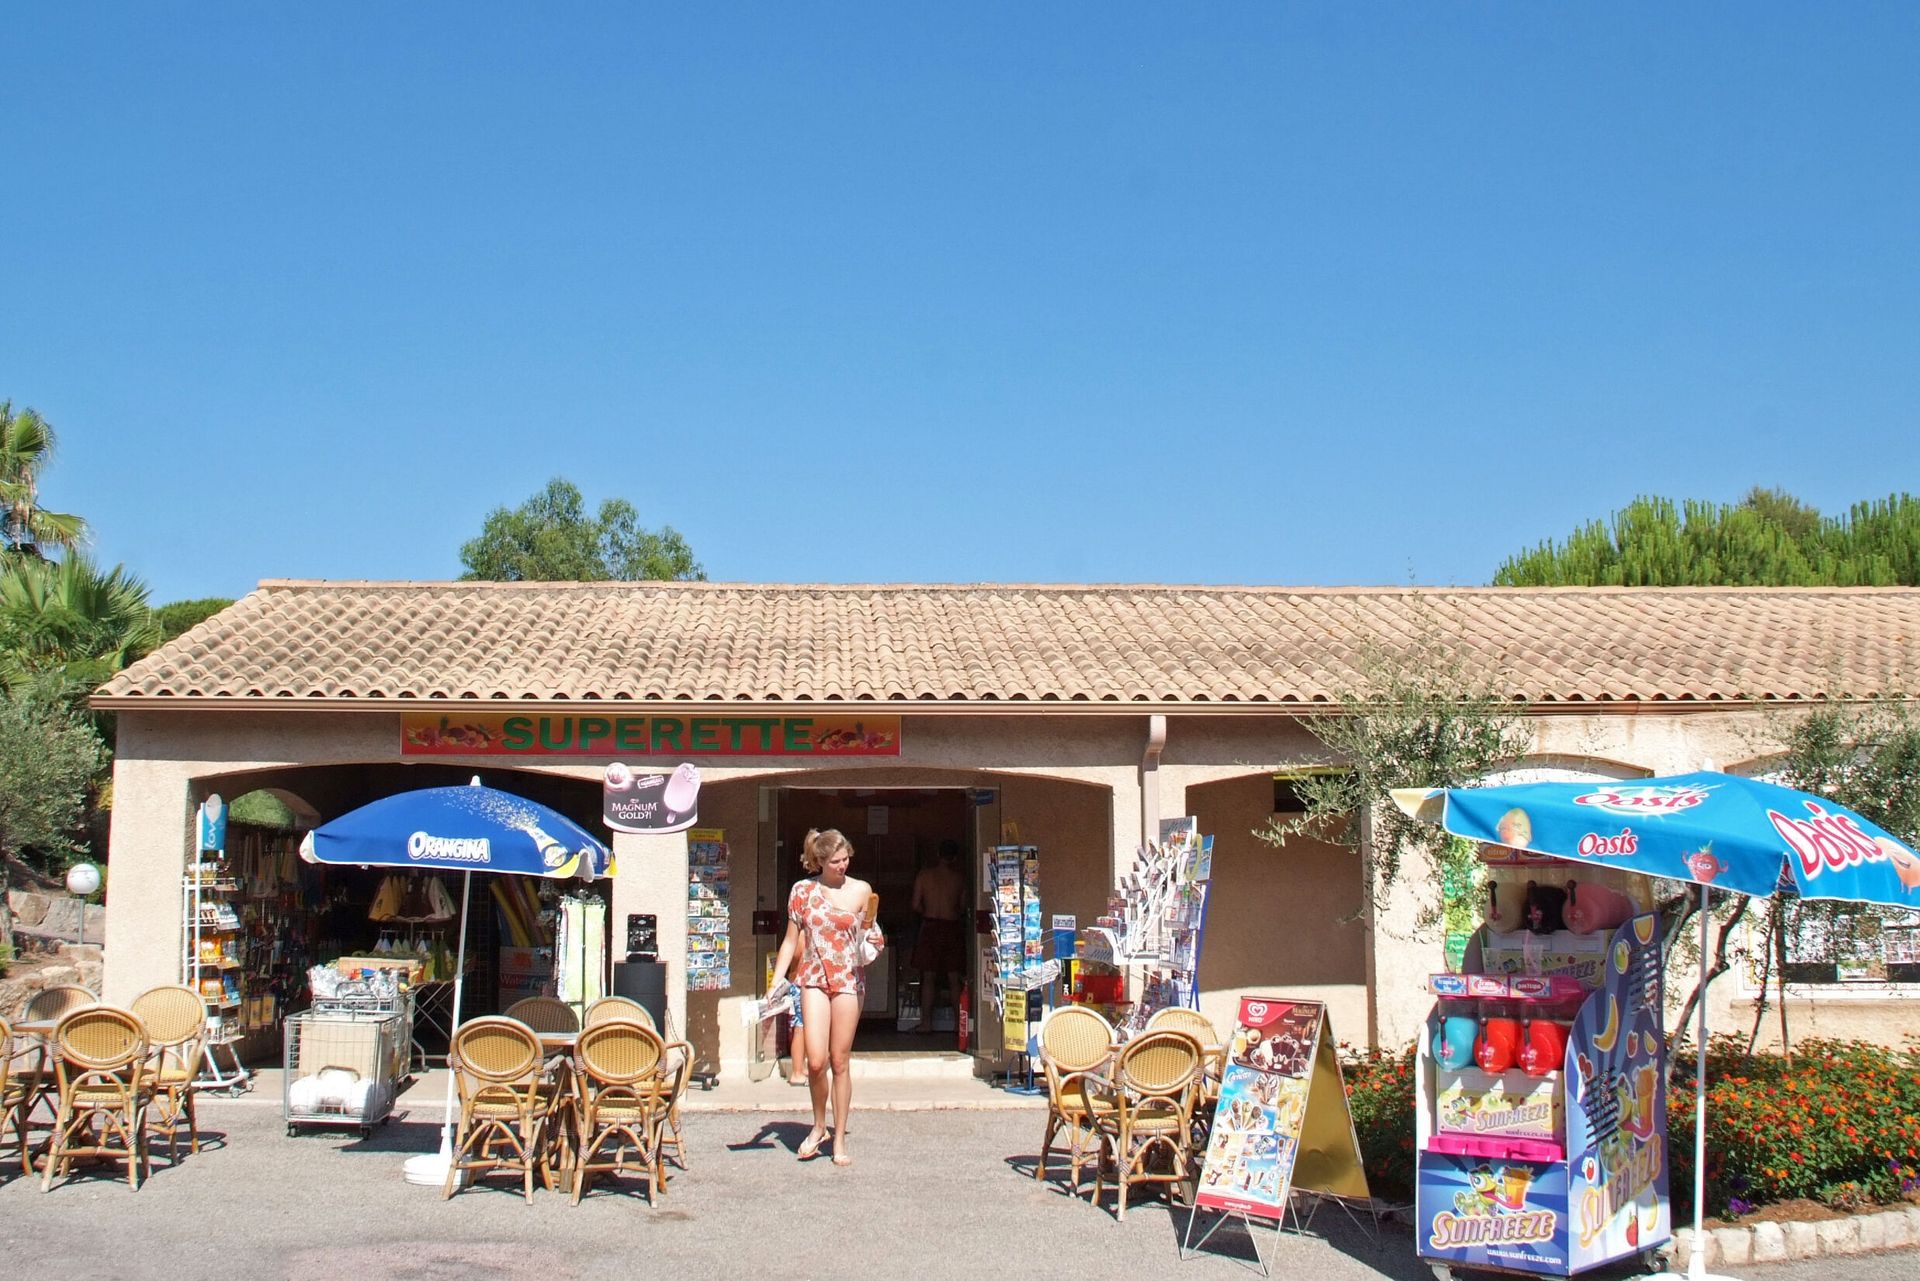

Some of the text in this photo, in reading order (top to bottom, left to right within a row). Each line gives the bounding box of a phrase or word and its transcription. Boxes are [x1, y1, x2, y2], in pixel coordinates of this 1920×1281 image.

[503, 717, 814, 750] SUPERETTE
[612, 802, 657, 811] MAGNUM
[1573, 788, 1712, 808] Oasis
[618, 811, 652, 820] GOLD?!
[1578, 828, 1638, 855] Oasis
[1769, 802, 1882, 876] Oasis
[1433, 1211, 1555, 1247] SUNFREEZE
